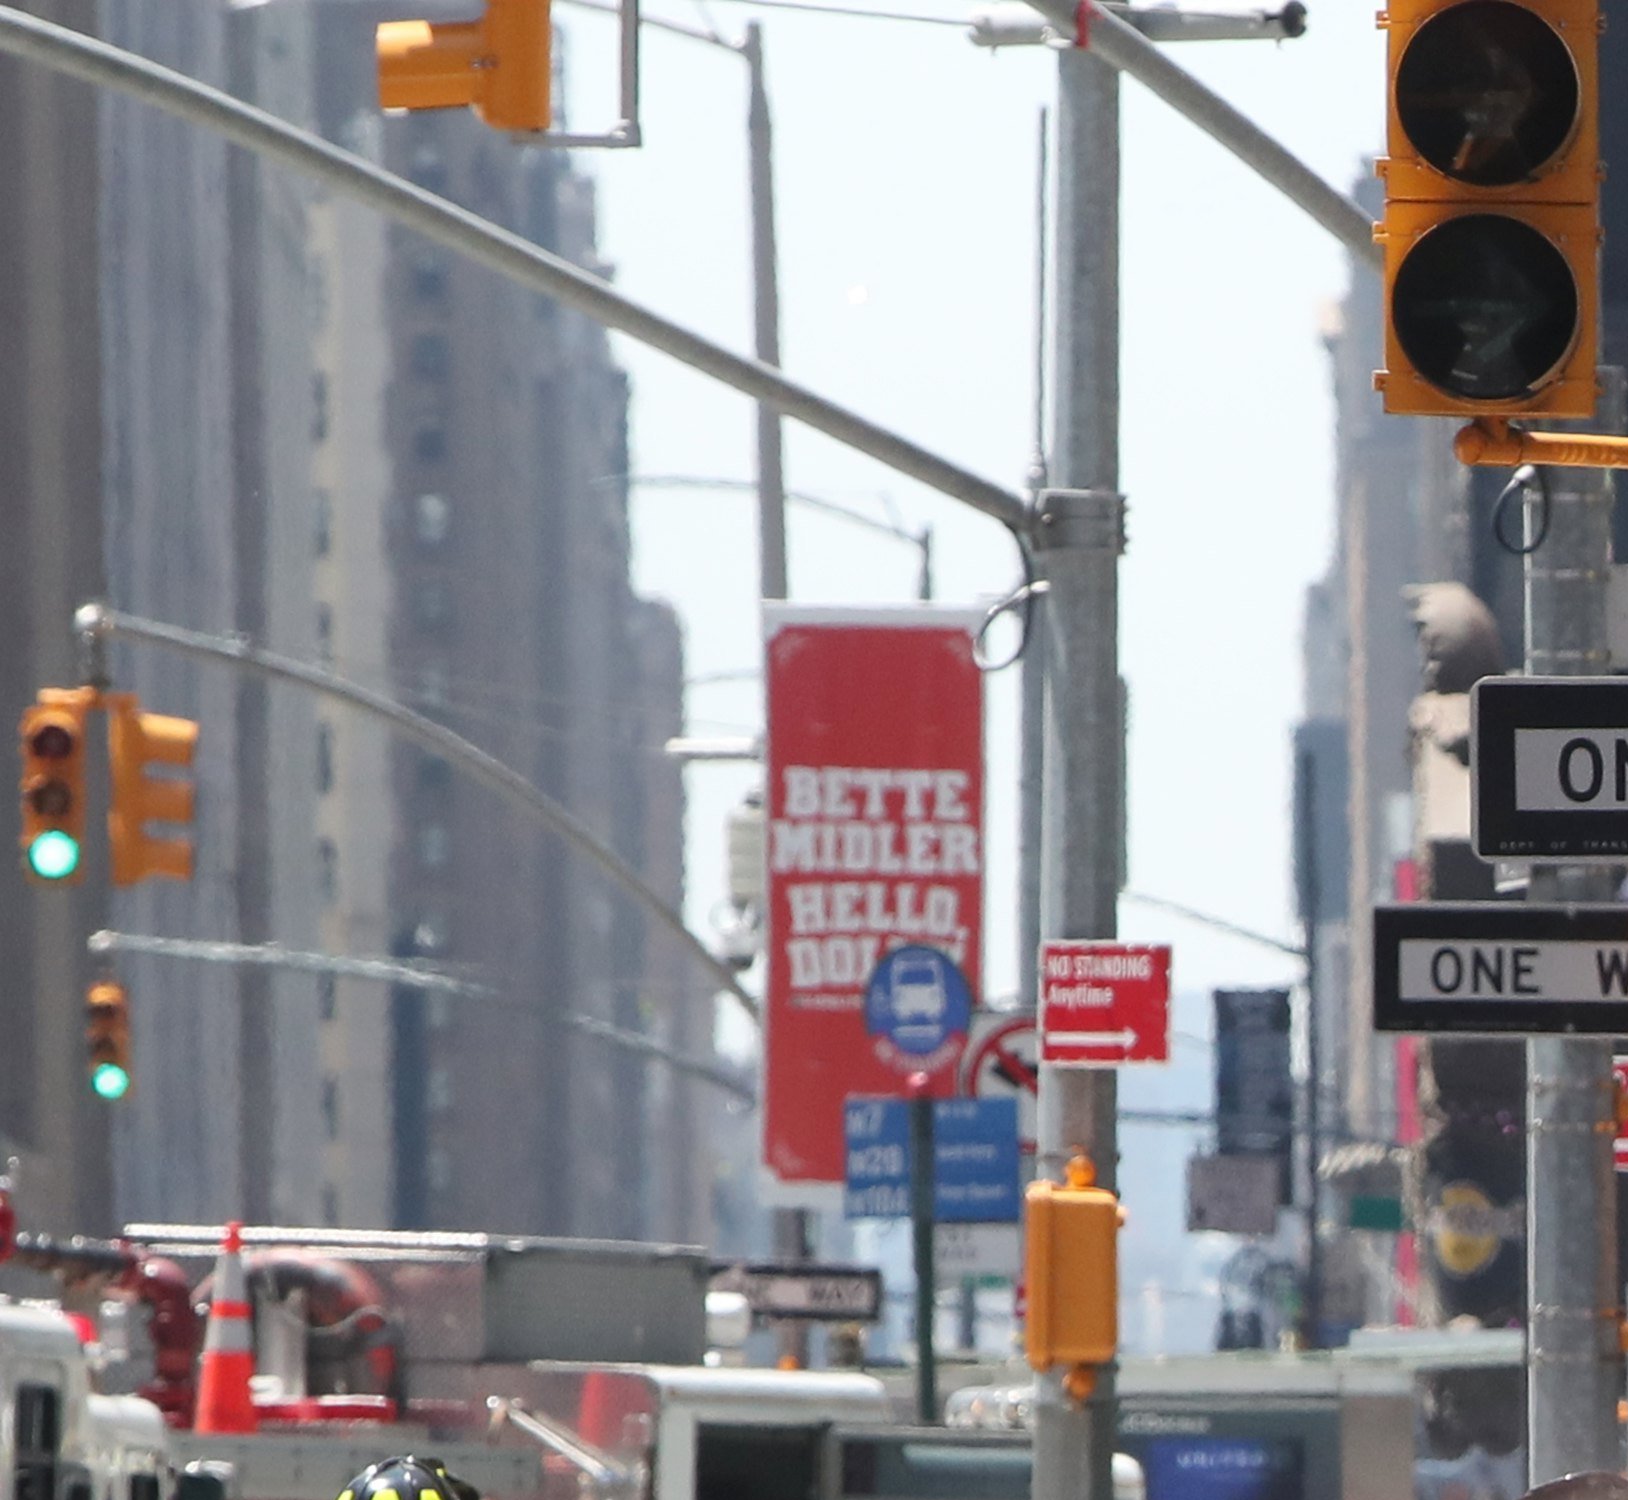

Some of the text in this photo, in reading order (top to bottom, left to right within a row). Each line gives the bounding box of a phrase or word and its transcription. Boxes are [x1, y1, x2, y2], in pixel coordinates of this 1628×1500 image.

[782, 765, 970, 821] BETTE
[771, 820, 979, 876] MIDLER
[1047, 954, 1152, 981] NO STANDING
[1430, 946, 1540, 995] ONE
